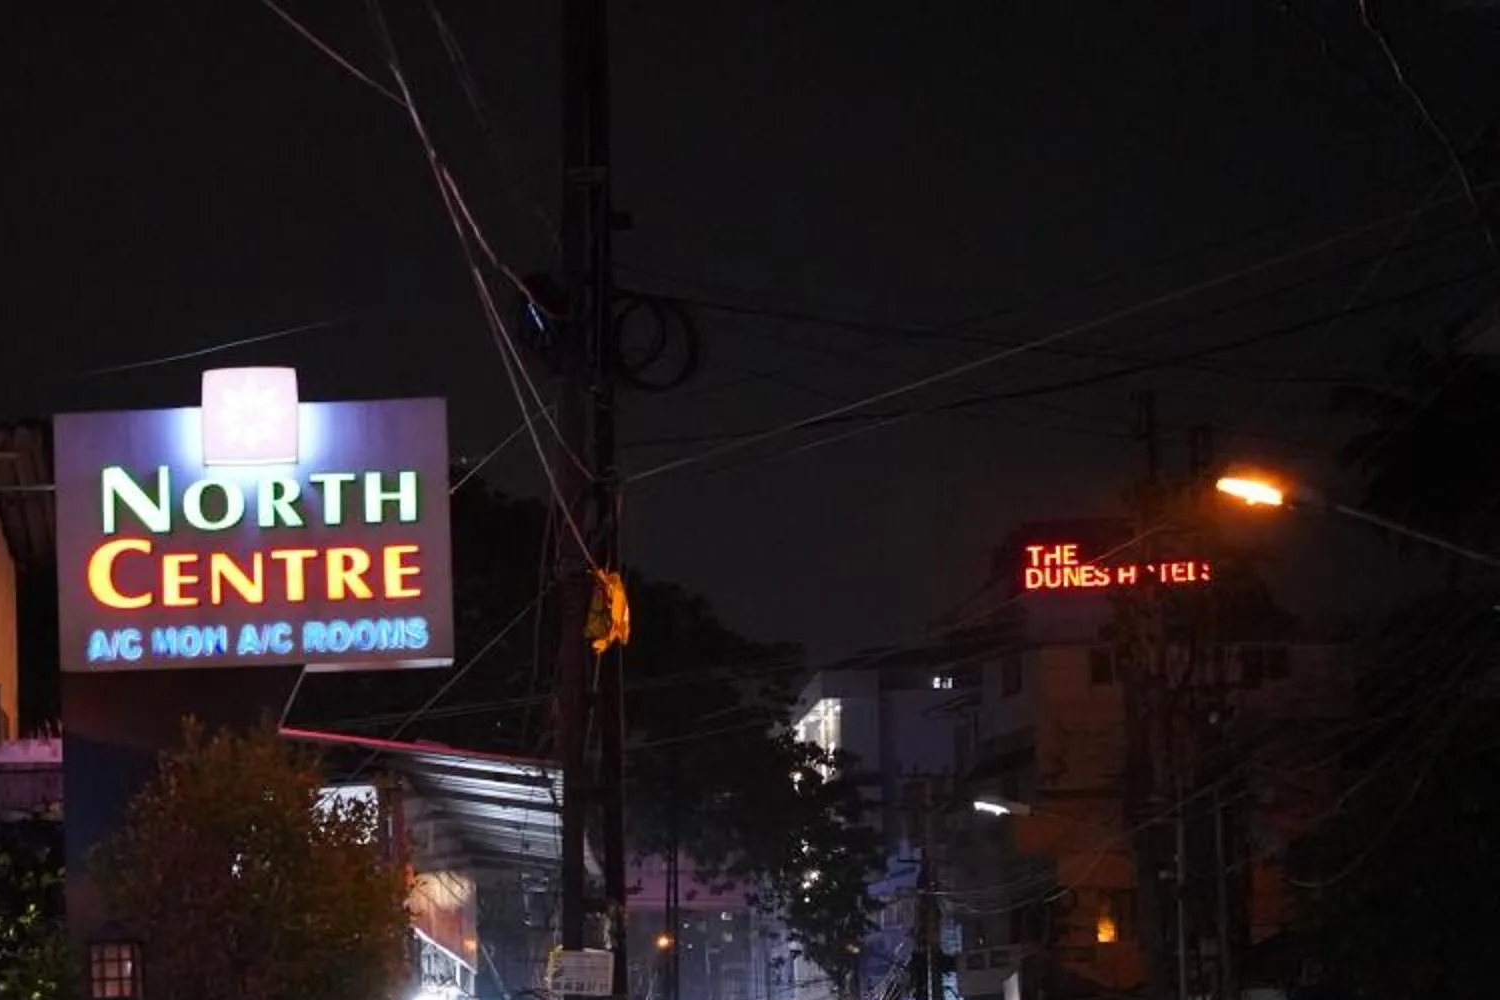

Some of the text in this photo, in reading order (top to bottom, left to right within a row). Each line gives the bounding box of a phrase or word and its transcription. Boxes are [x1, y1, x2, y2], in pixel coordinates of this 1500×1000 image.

[102, 465, 418, 534] NORTH
[87, 538, 422, 609] CENTRE
[1025, 544, 1079, 566] THE
[1025, 565, 1110, 589] DUNES
[87, 627, 143, 661] A/C
[237, 620, 293, 655] A/C
[303, 617, 429, 652] ROOMS
